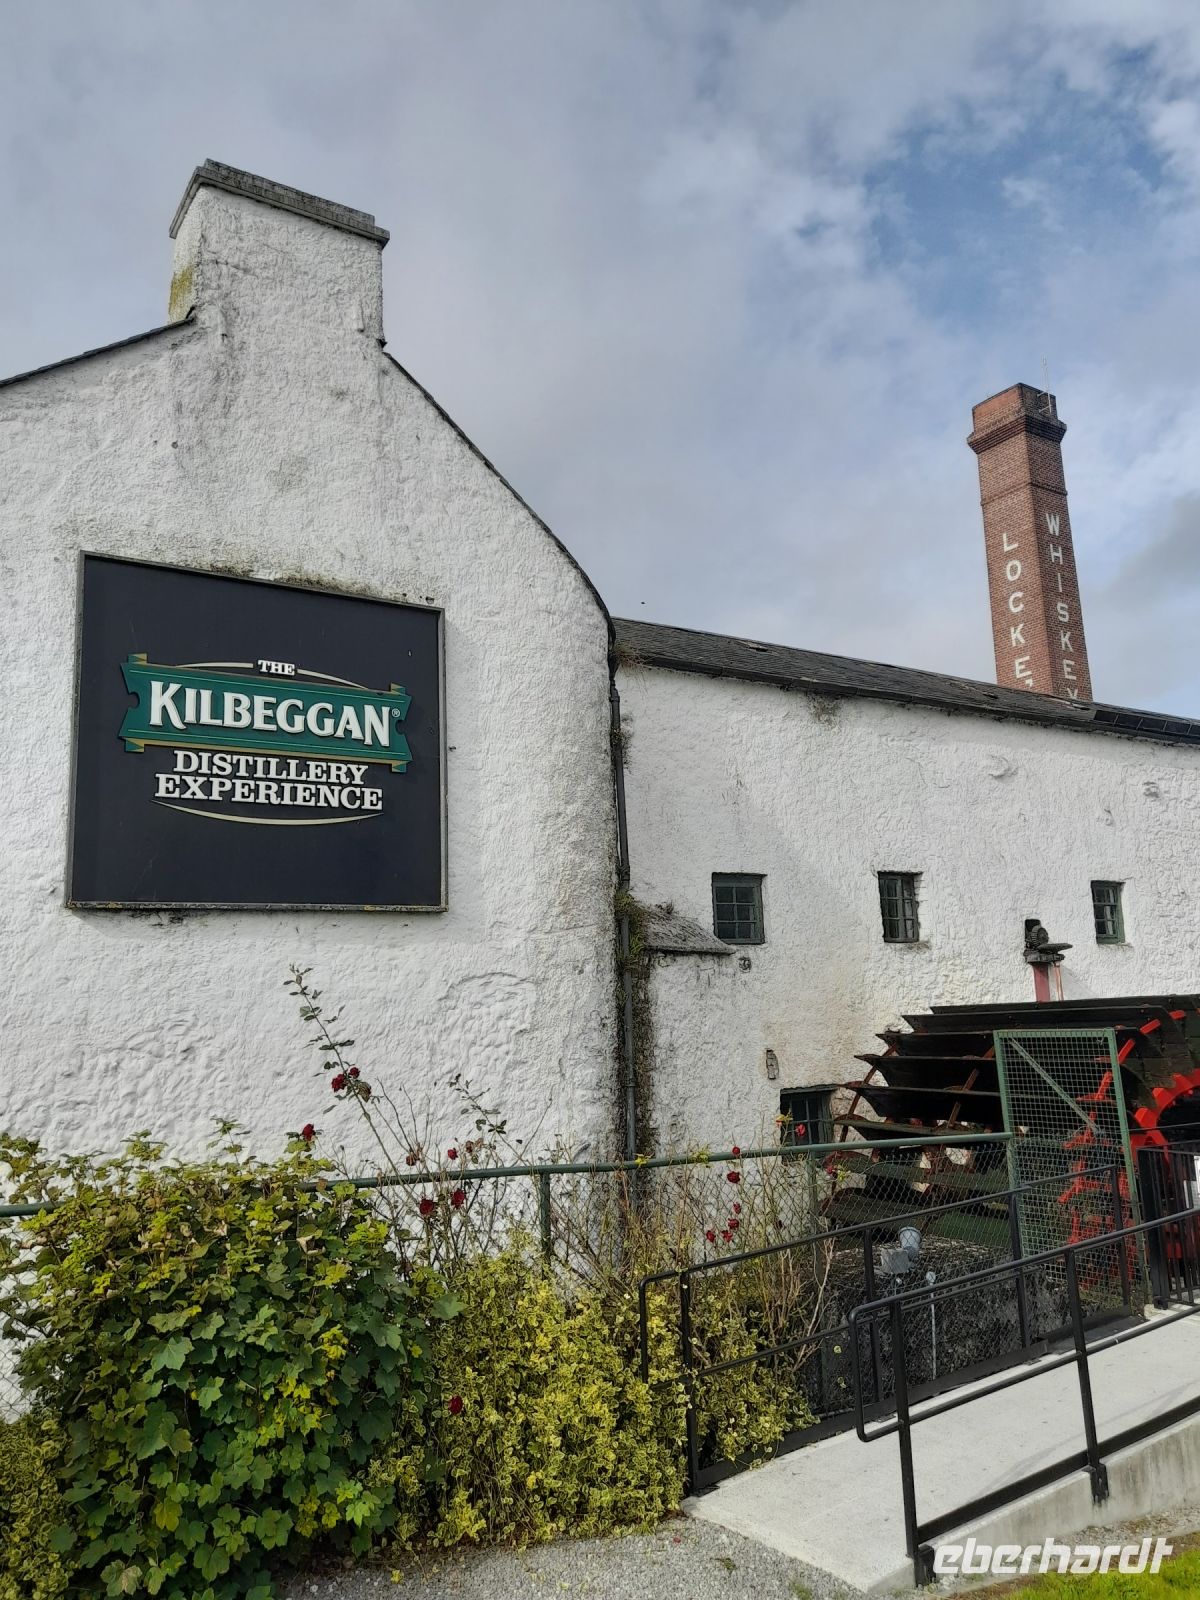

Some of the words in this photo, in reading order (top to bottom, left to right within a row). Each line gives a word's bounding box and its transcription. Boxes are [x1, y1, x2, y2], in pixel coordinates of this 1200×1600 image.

[257, 659, 295, 676] THE
[173, 750, 369, 785] DISTILLERY
[154, 773, 383, 811] EXPERIENCE
